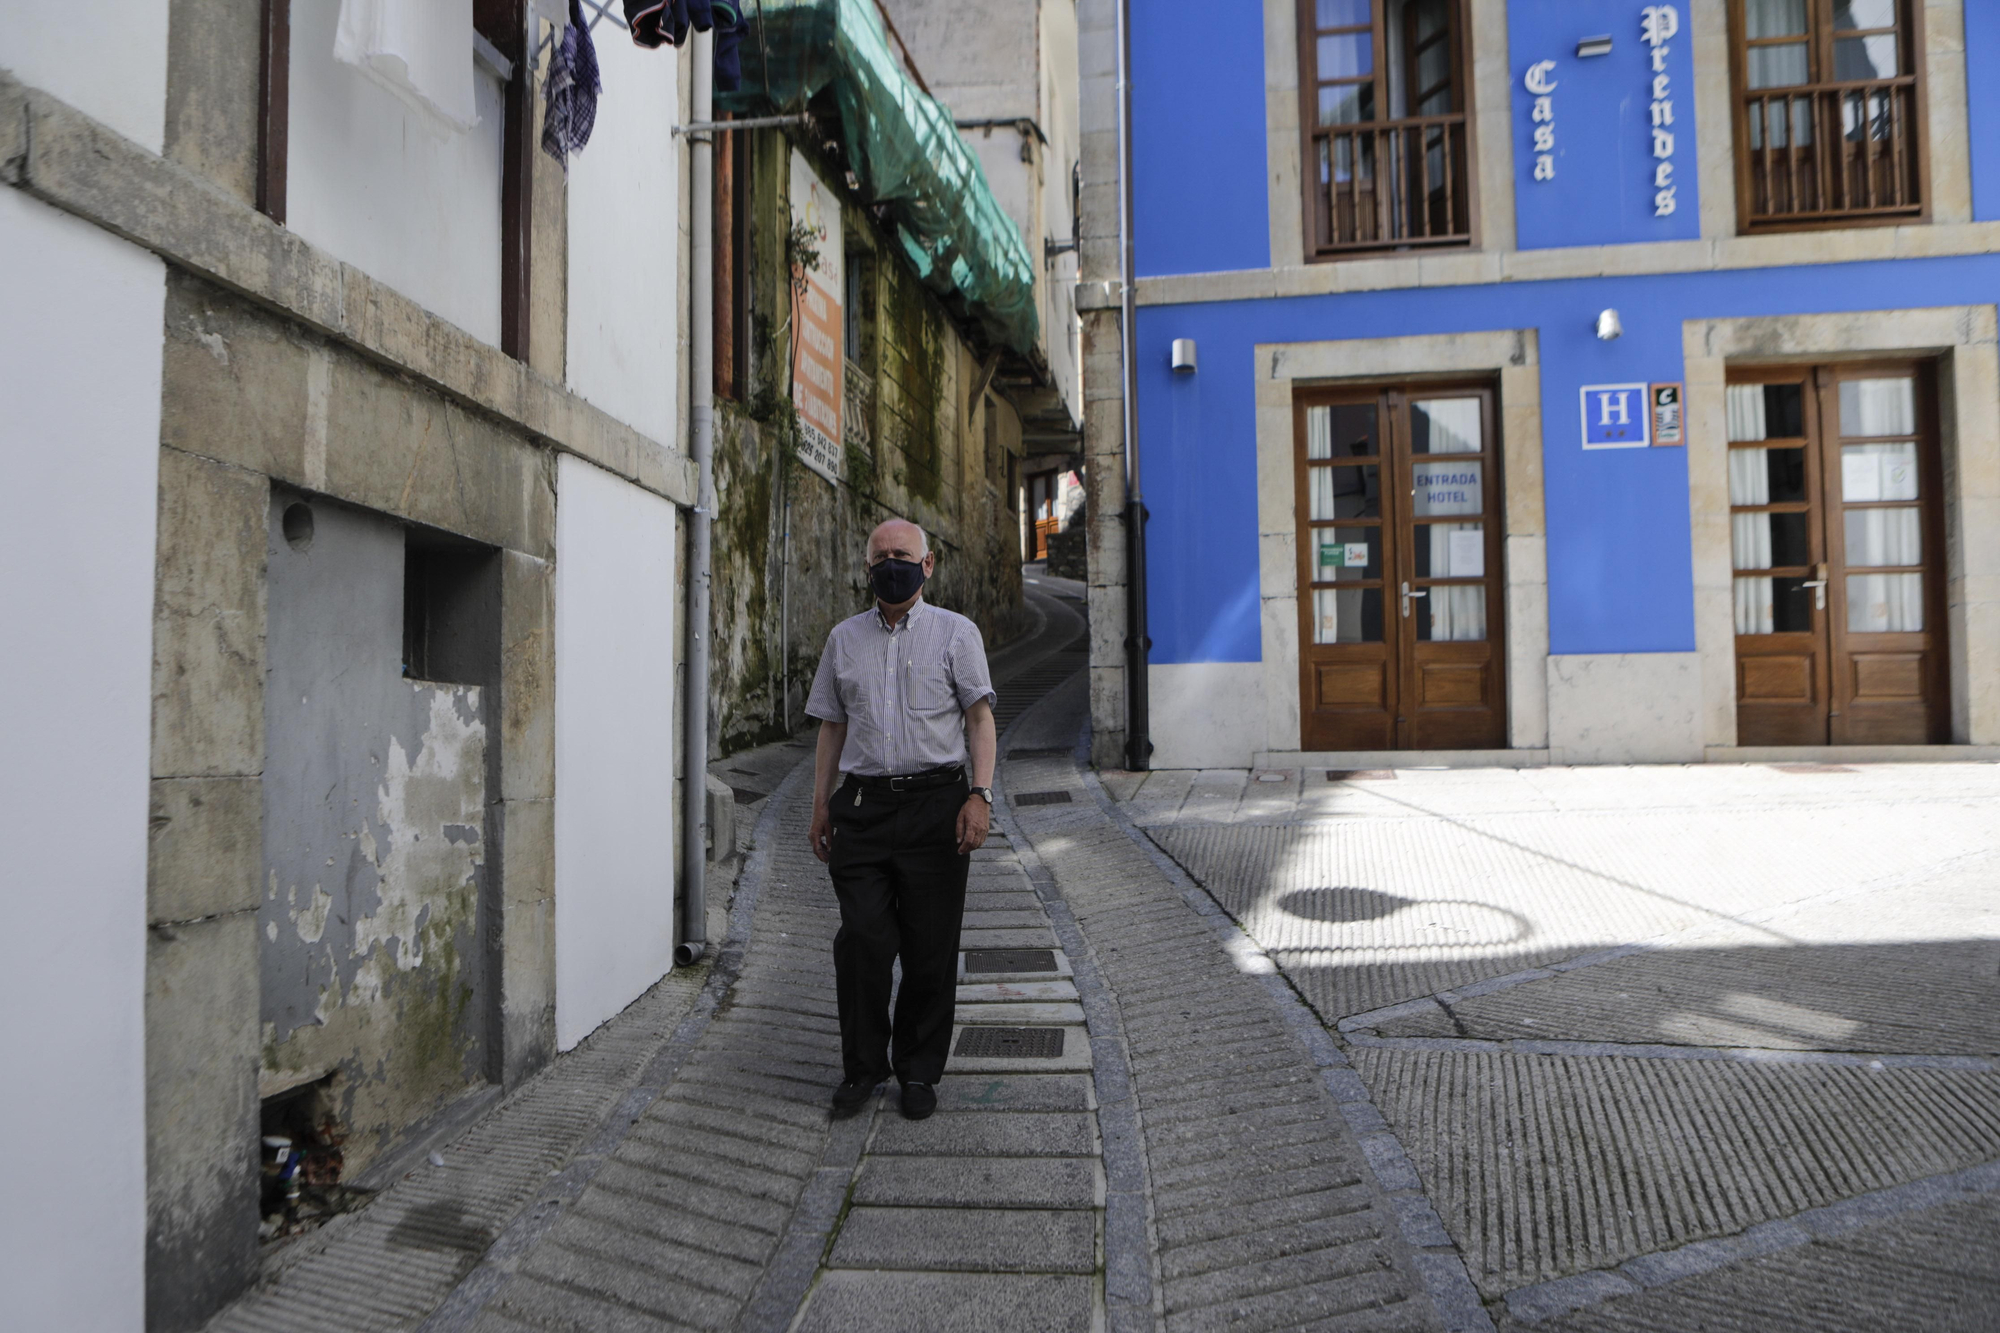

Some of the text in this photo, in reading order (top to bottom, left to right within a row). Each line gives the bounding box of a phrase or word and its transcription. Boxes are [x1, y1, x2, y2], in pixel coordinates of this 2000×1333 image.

[1524, 59, 1558, 181] Casa
[1640, 4, 1679, 217] Prendes
[1597, 391, 1632, 425] H
[814, 448, 825, 466] 207
[1417, 472, 1477, 487] ENTRADA
[1427, 491, 1468, 504] HOTEL
